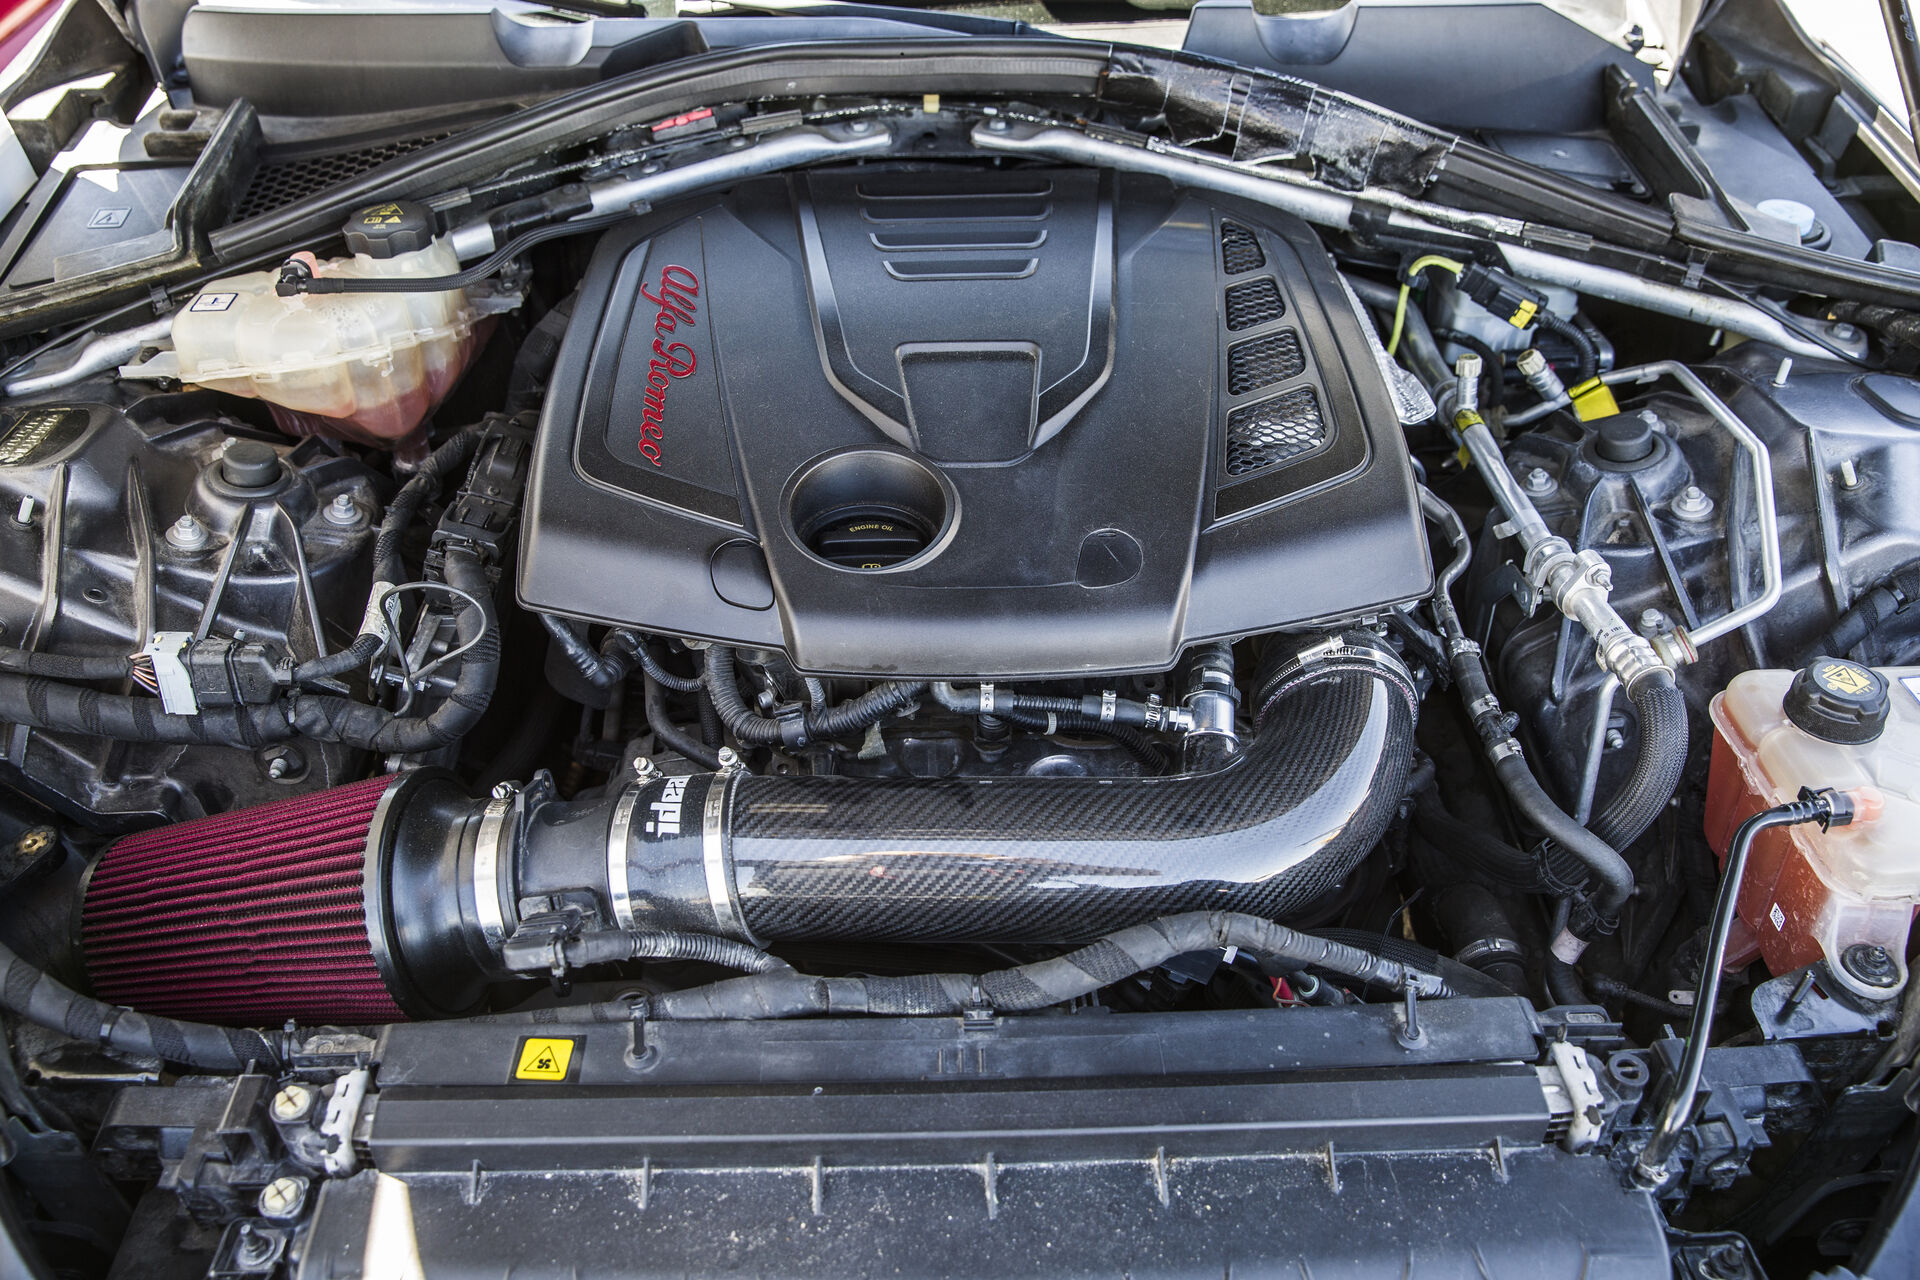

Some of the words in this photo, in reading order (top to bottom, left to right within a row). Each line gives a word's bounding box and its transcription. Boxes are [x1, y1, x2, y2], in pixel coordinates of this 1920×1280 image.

[640, 264, 699, 340] Alfa
[638, 337, 697, 467] Romeo
[849, 524, 880, 533] ENGINE
[881, 524, 894, 532] OIL
